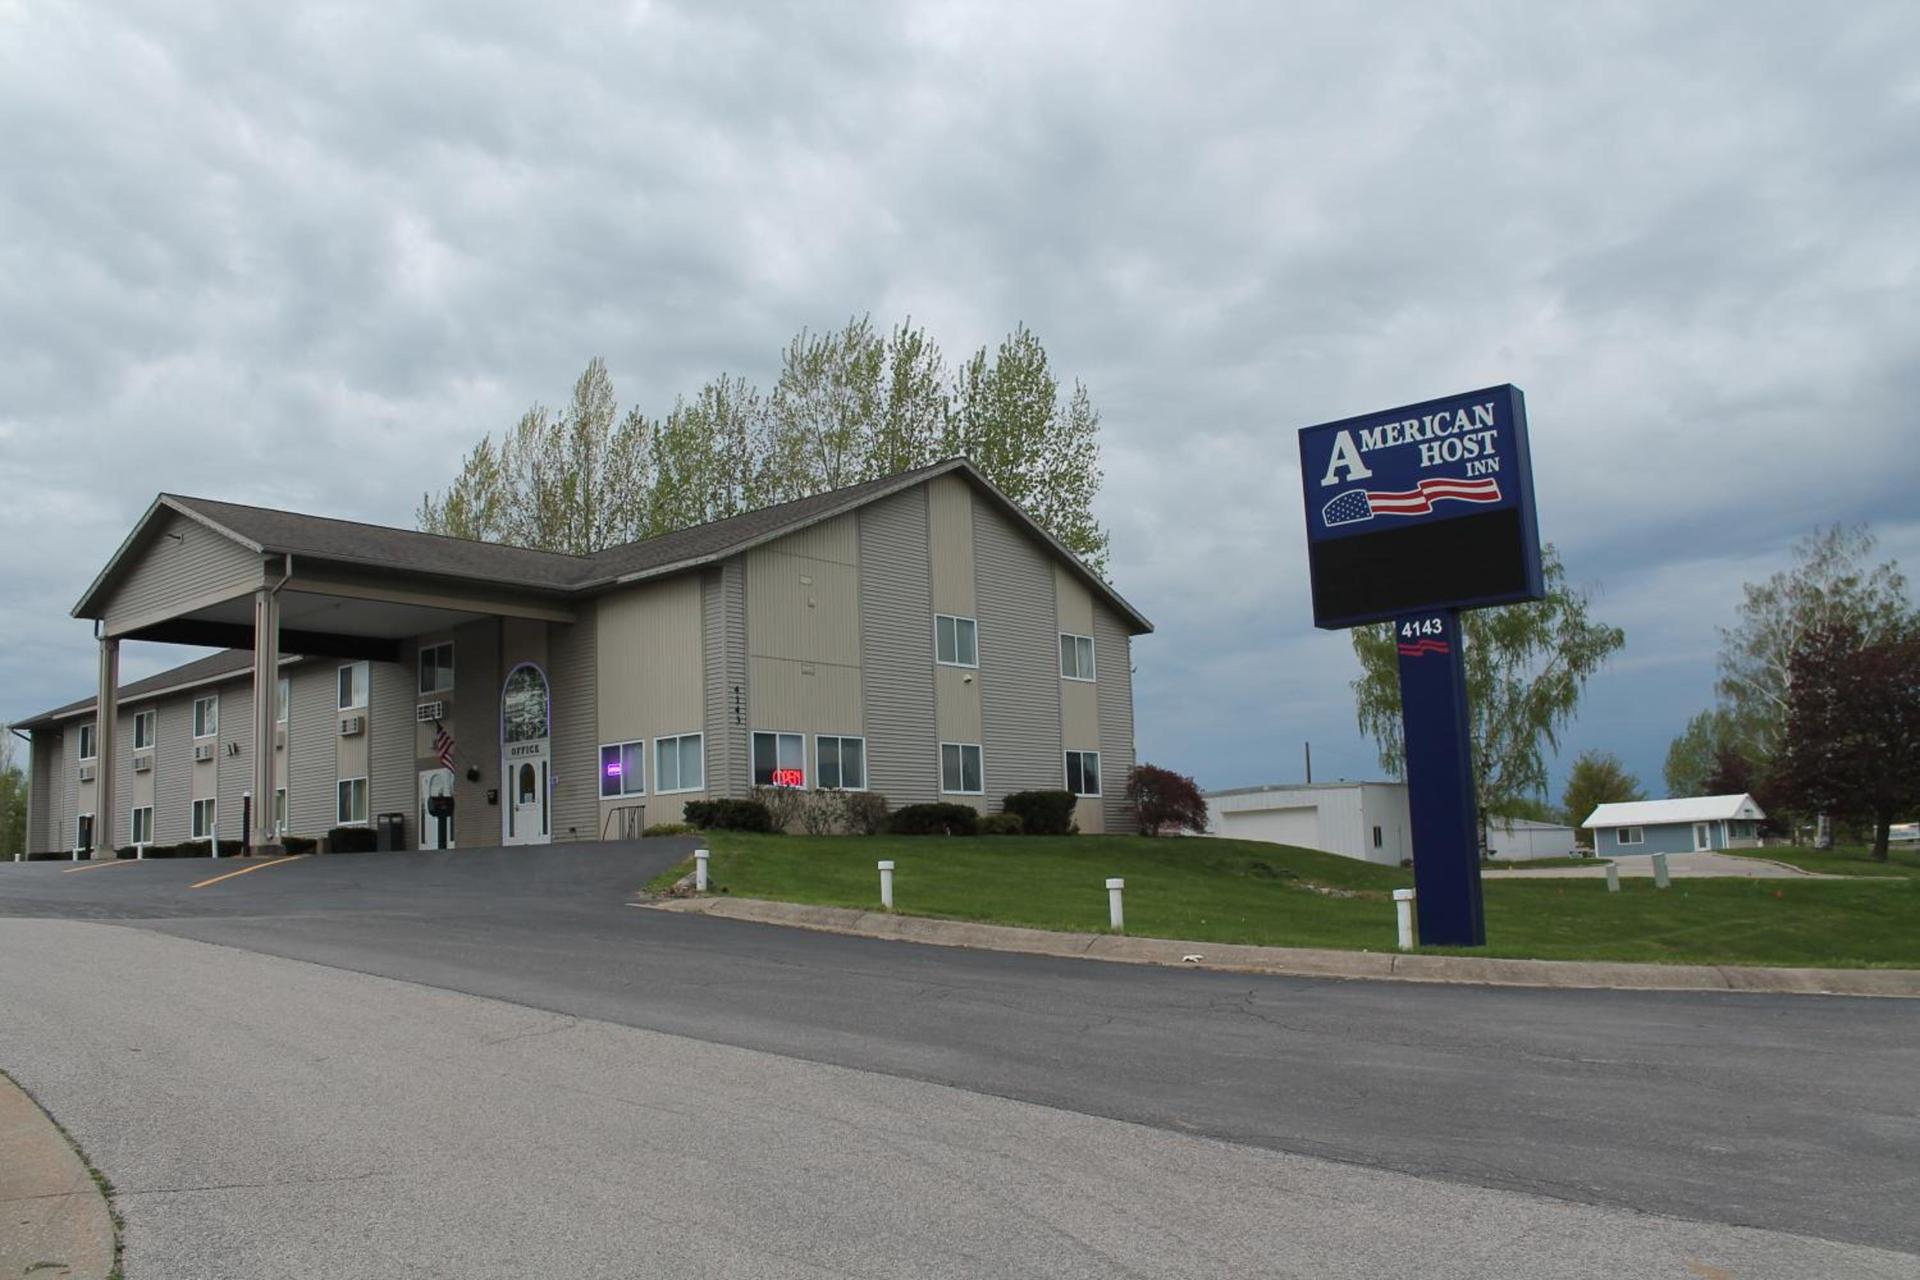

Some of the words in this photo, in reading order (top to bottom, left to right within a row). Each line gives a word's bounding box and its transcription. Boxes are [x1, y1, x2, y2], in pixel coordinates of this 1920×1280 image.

[1321, 403, 1495, 487] AMERICAN
[1419, 430, 1498, 468] HOST
[1466, 457, 1500, 477] INN
[1401, 618, 1443, 638] 4143
[511, 744, 540, 756] OFFICE
[772, 768, 803, 787] OPEN
